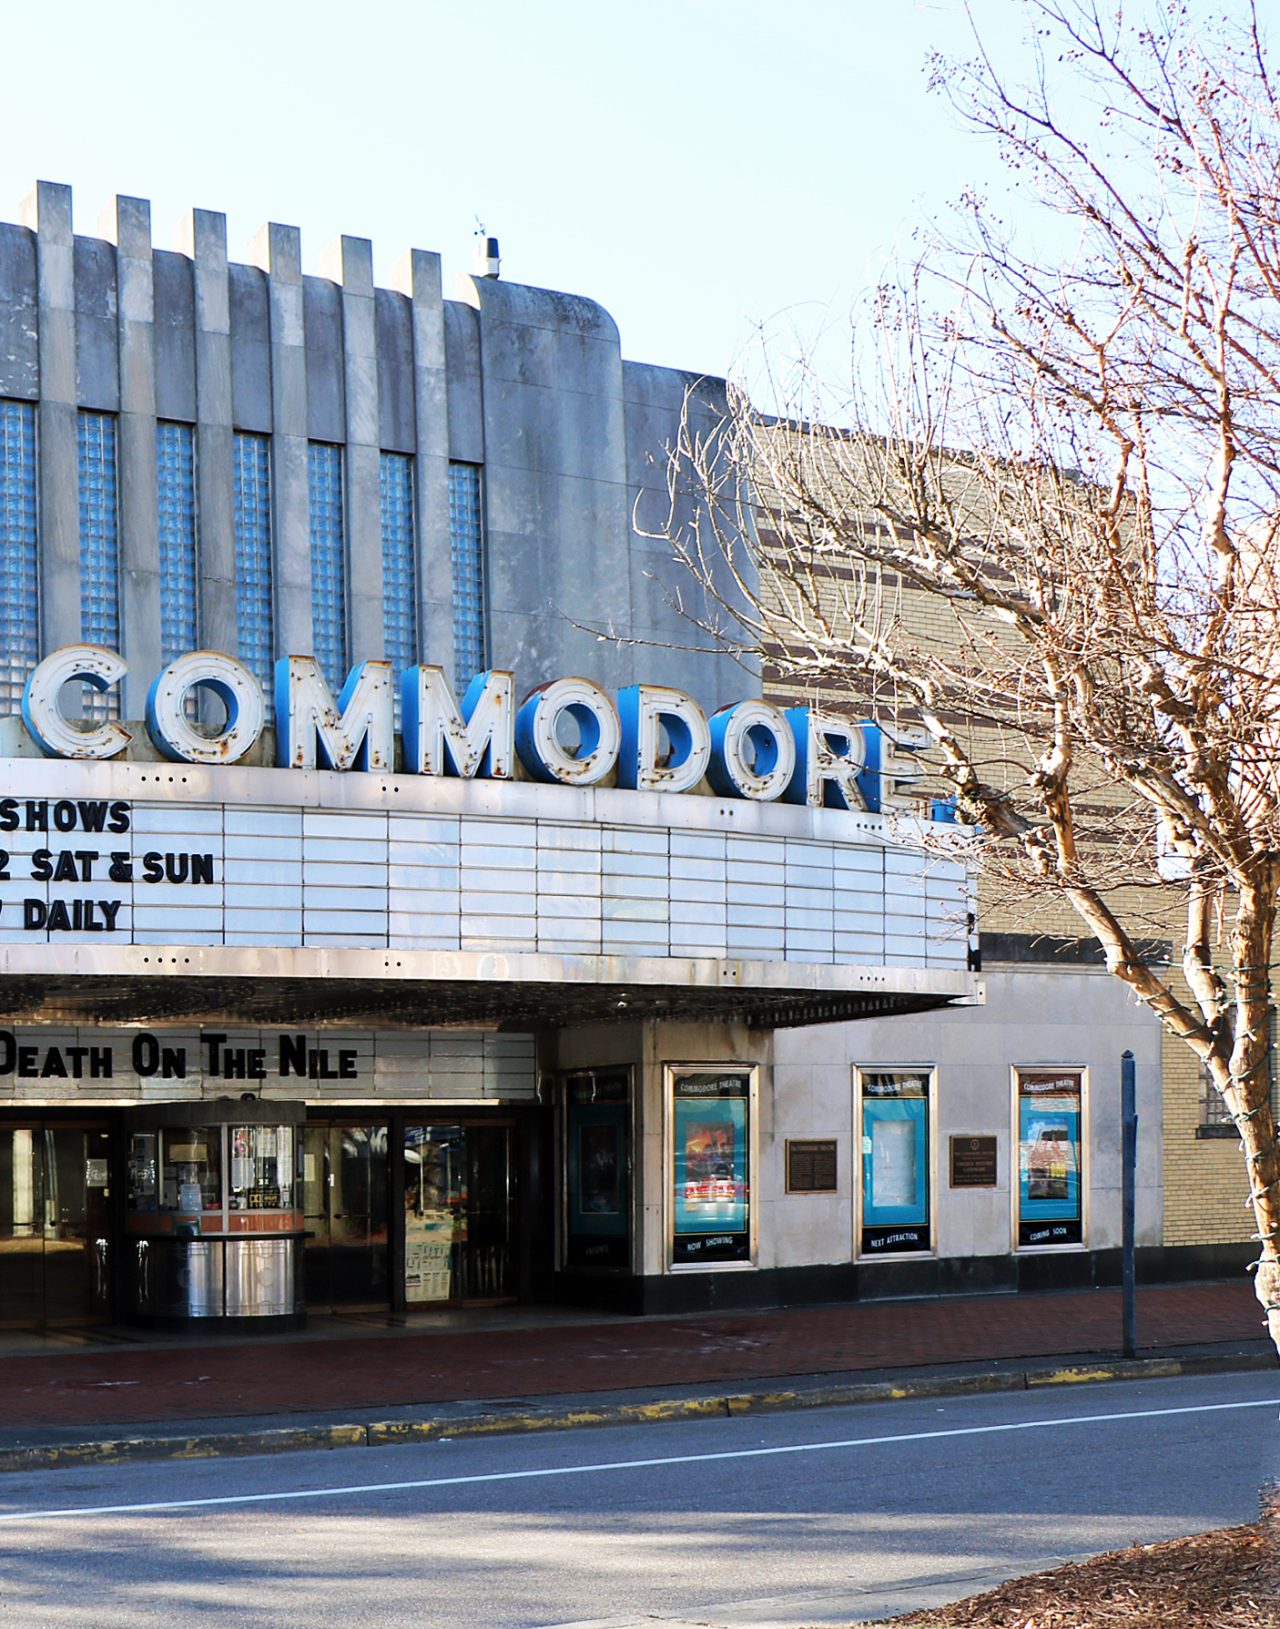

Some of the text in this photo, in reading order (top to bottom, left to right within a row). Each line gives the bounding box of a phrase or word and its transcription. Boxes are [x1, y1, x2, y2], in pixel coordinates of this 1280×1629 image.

[21, 641, 934, 816] COMMODORE
[30, 848, 99, 882] SAT
[108, 851, 133, 883] &
[142, 851, 214, 884] SUN
[24, 898, 121, 931] DAILY
[132, 1033, 186, 1079] ON
[200, 1033, 267, 1079] THE
[278, 1034, 358, 1079] NILE
[680, 1083, 718, 1092] COMMODORE
[687, 1236, 734, 1251] NOW SHOWING
[870, 1232, 919, 1247] NEXT ATTRACTION
[1030, 1227, 1067, 1241] COMING SOON
